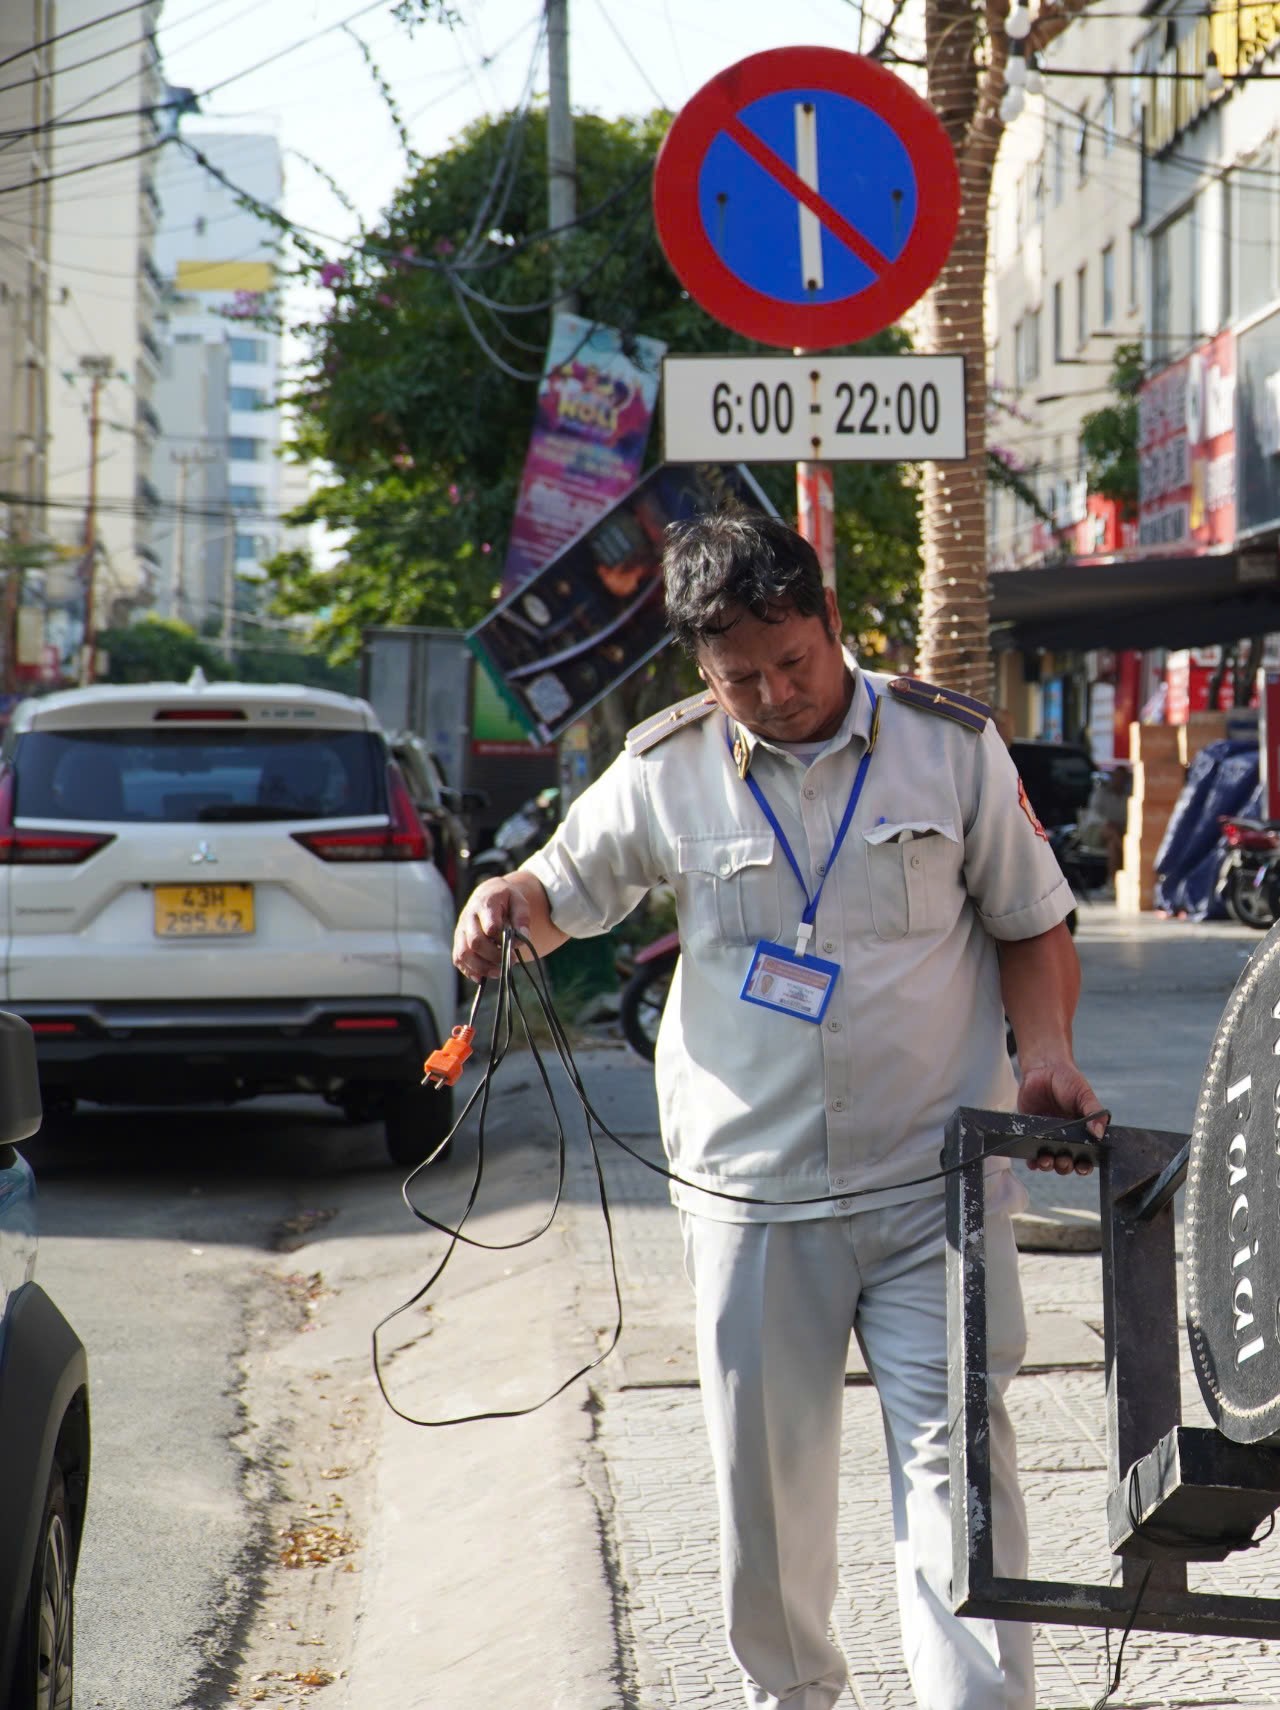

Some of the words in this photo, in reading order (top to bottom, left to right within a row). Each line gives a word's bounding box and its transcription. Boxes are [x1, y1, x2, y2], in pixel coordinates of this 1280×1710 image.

[711, 381, 794, 435] 6:00
[834, 381, 940, 435] 22:00
[1225, 1073, 1265, 1372] Facial
